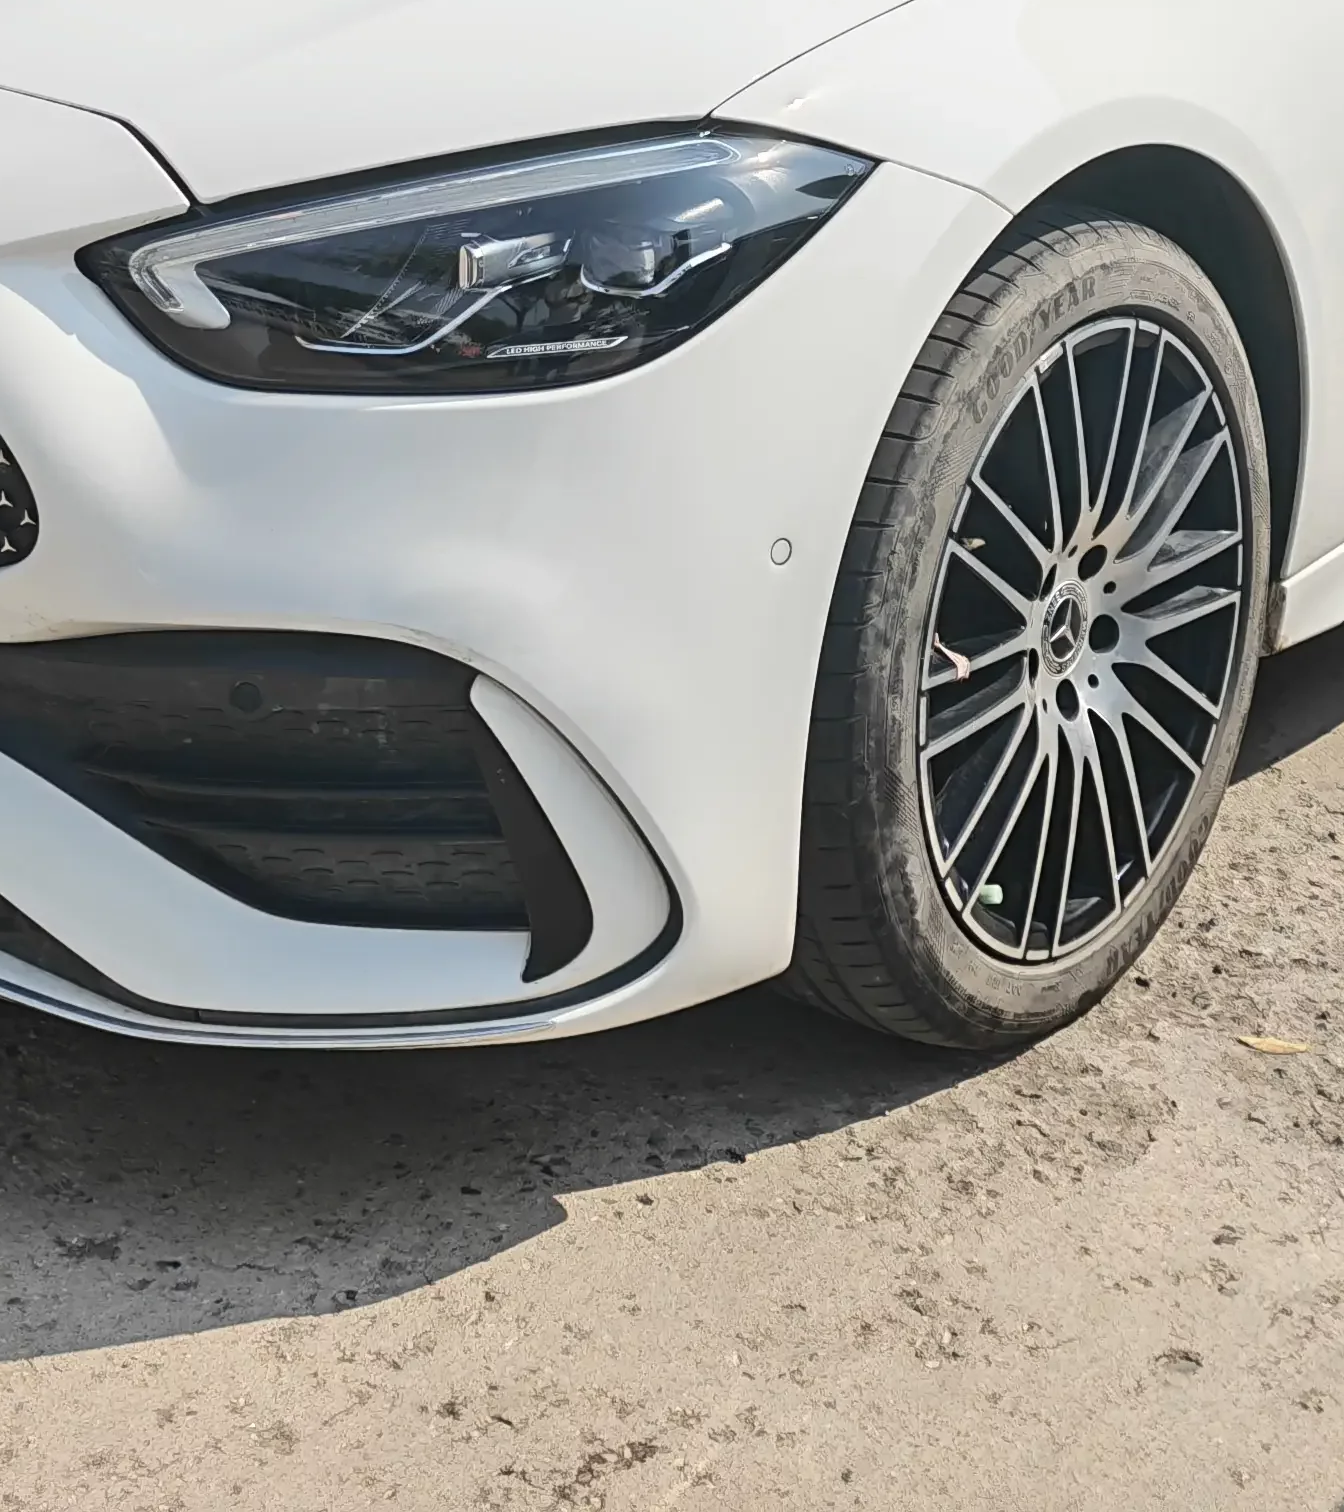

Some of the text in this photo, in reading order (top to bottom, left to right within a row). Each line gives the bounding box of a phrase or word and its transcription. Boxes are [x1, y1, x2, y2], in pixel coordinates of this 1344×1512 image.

[506, 339, 607, 355] LED HIGH PERFORMANCE
